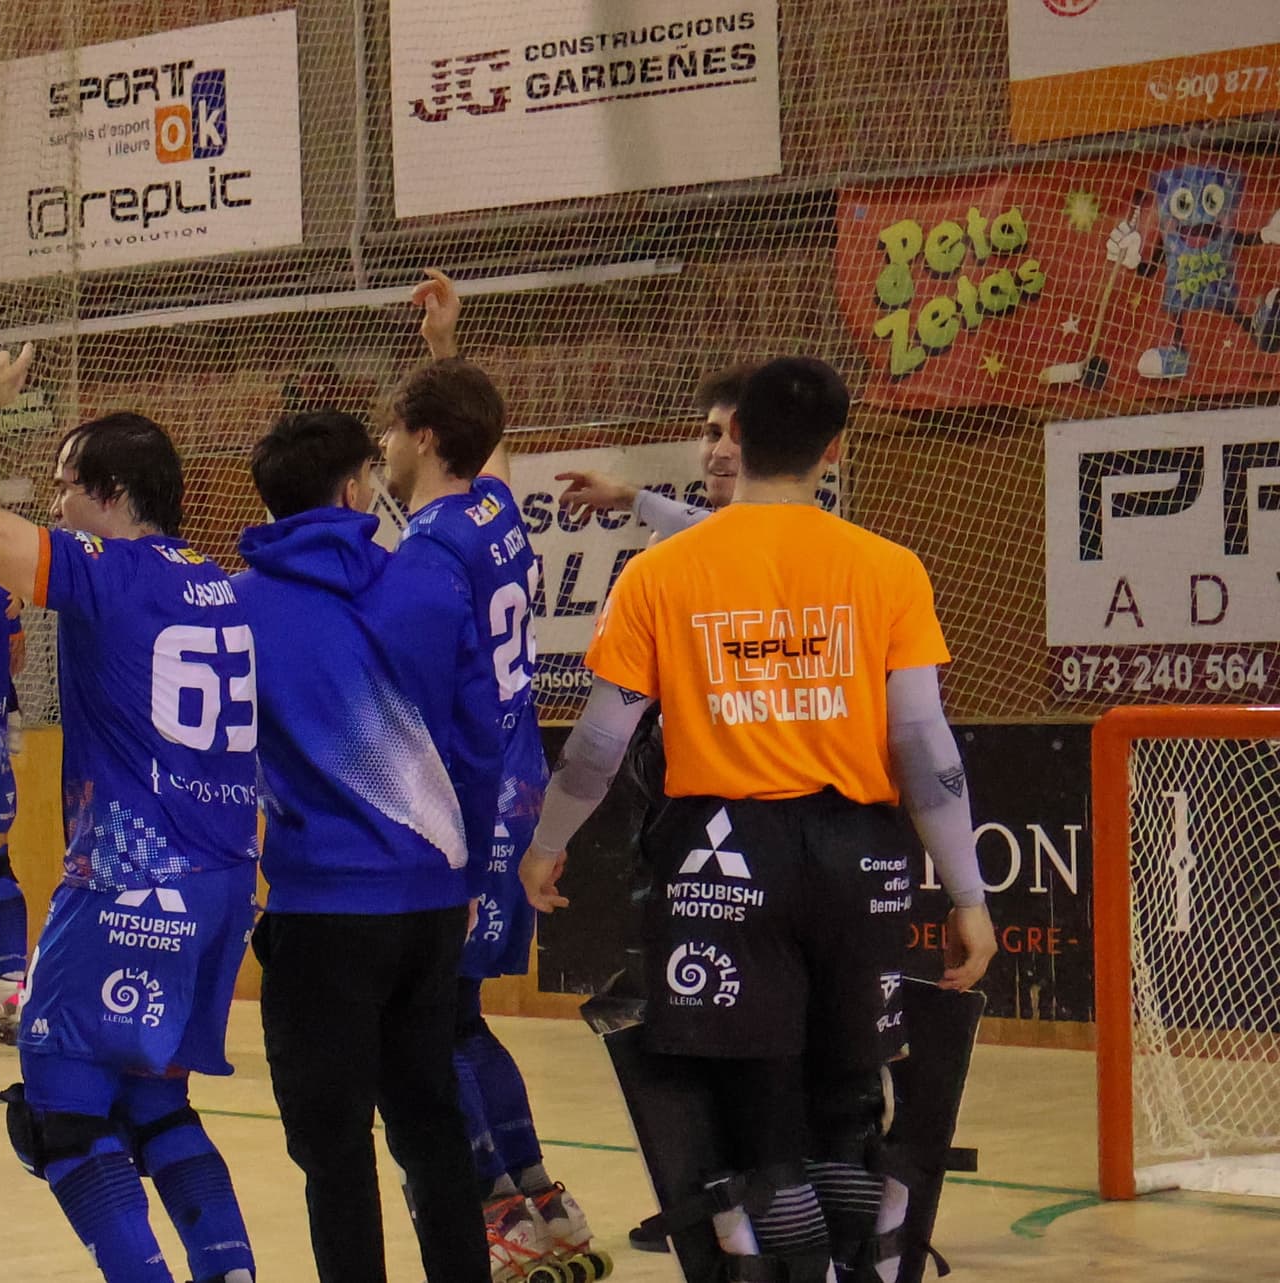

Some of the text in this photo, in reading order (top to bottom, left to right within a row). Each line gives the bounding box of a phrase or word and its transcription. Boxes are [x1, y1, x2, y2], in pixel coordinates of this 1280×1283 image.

[525, 12, 755, 62] CONSTRUCCIONS
[50, 61, 193, 118] SPORT
[525, 42, 757, 100] GARDEÑES
[1225, 67, 1269, 93] 877
[104, 226, 208, 247] EVOLUTION
[692, 605, 854, 684] TEAM
[152, 624, 258, 752] 63
[1062, 652, 1267, 693] 973 240 564
[708, 685, 848, 726] PONS LLEIDA
[667, 883, 764, 906] MITSUBISHI
[672, 901, 746, 922] MOTORS
[98, 910, 197, 937] MITSUBISHI
[108, 930, 181, 952] MOTORS
[690, 941, 741, 1008] L'APLEC
[126, 967, 165, 1028] L'APLEC
[103, 1014, 134, 1025] LLEIDA
